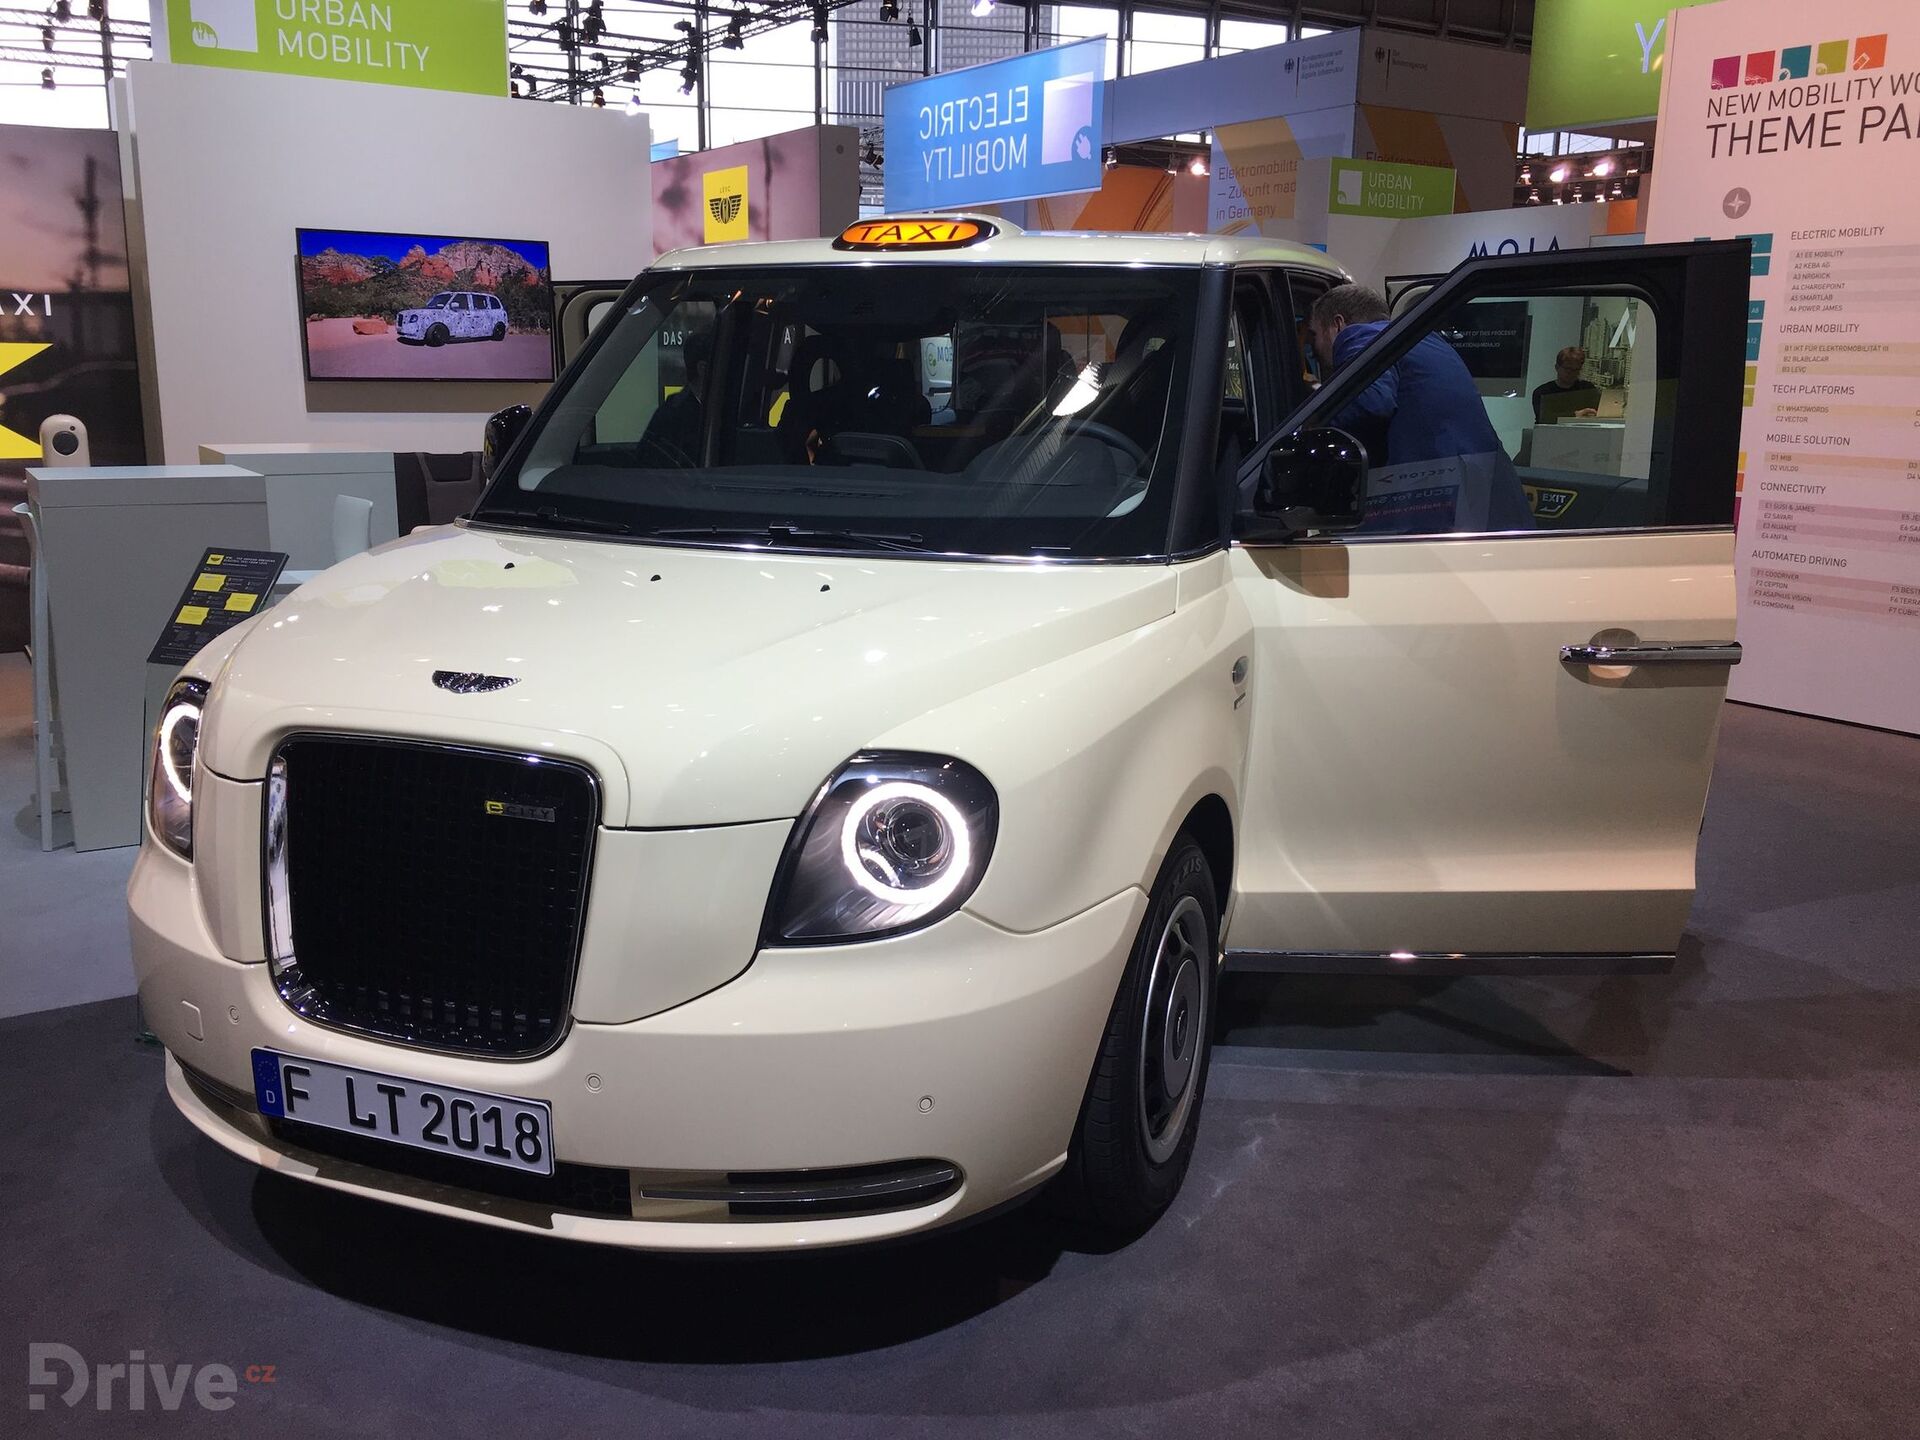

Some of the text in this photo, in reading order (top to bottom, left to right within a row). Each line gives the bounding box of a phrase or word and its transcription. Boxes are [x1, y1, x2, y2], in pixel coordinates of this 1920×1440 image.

[275, 0, 392, 33] URBAN
[278, 28, 430, 72] MOBILITY
[1707, 91, 1762, 119] NEW
[1768, 76, 1883, 111] MOBILITY
[1706, 102, 1920, 159] THEME PA
[1369, 171, 1413, 190] URBAN
[1228, 182, 1270, 200] Zukunft
[1367, 191, 1425, 209] MOBILITY
[1216, 205, 1276, 220] in Germany
[859, 224, 961, 241] TAXI
[1791, 226, 1885, 241] ELECTRIC MOBILITY
[0, 293, 52, 316] XI
[1779, 323, 1860, 334] URBAN MOBILITY
[663, 330, 683, 346] DAS
[1773, 384, 1855, 395] TECH PLATFORMS
[1766, 433, 1850, 446] MOBILE SOLUTION
[1760, 482, 1826, 494] CONNECTIVITY
[1542, 493, 1567, 504] EXIT
[1751, 550, 1848, 568] AUTOMATED DRIVING
[266, 1090, 276, 1104] D
[283, 1065, 542, 1164] F LT 2018
